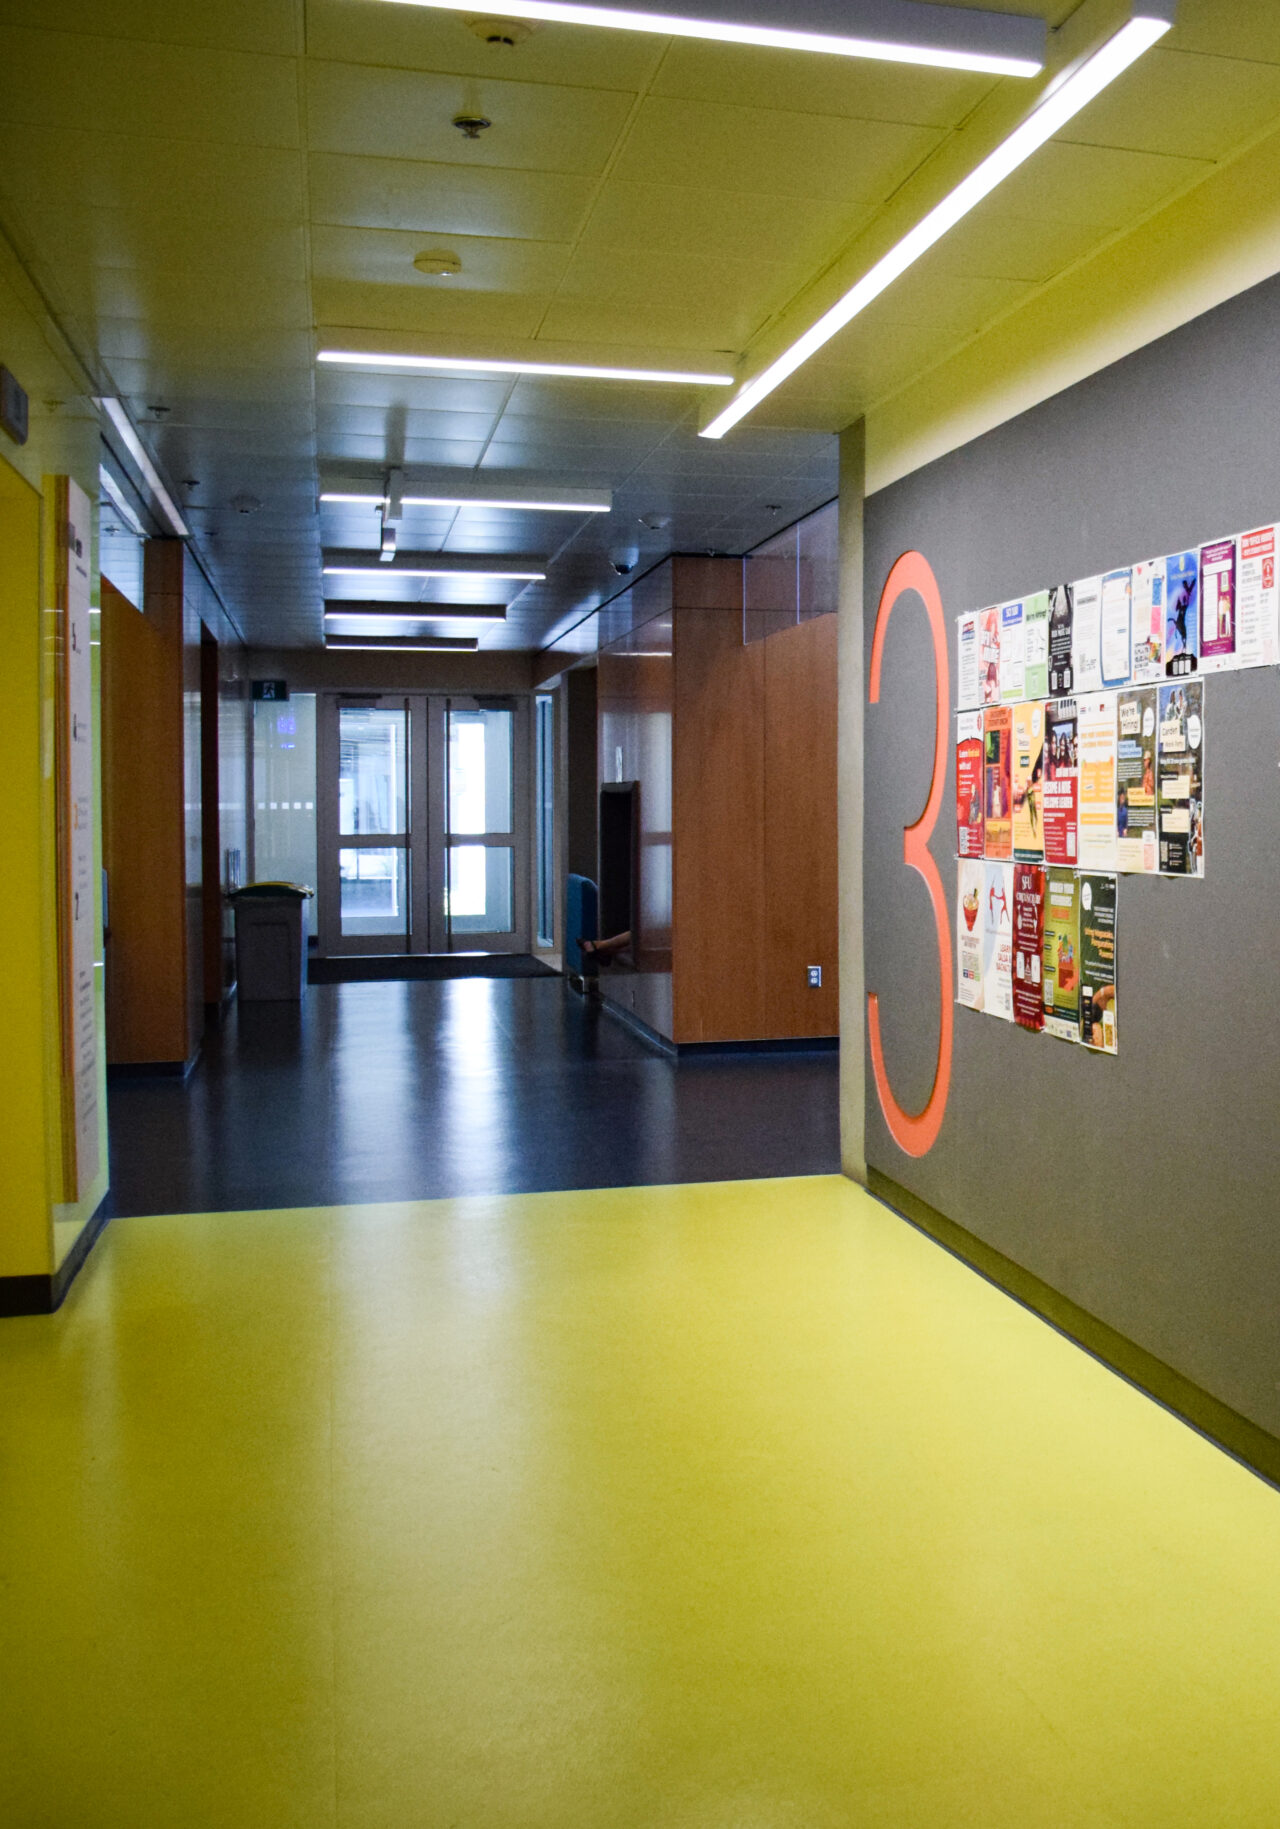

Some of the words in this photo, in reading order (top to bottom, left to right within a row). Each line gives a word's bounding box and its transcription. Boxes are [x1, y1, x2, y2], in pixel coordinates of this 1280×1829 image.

[1122, 707, 1135, 718] We're
[1123, 720, 1138, 732] Hiring!
[868, 549, 953, 1158] 3
